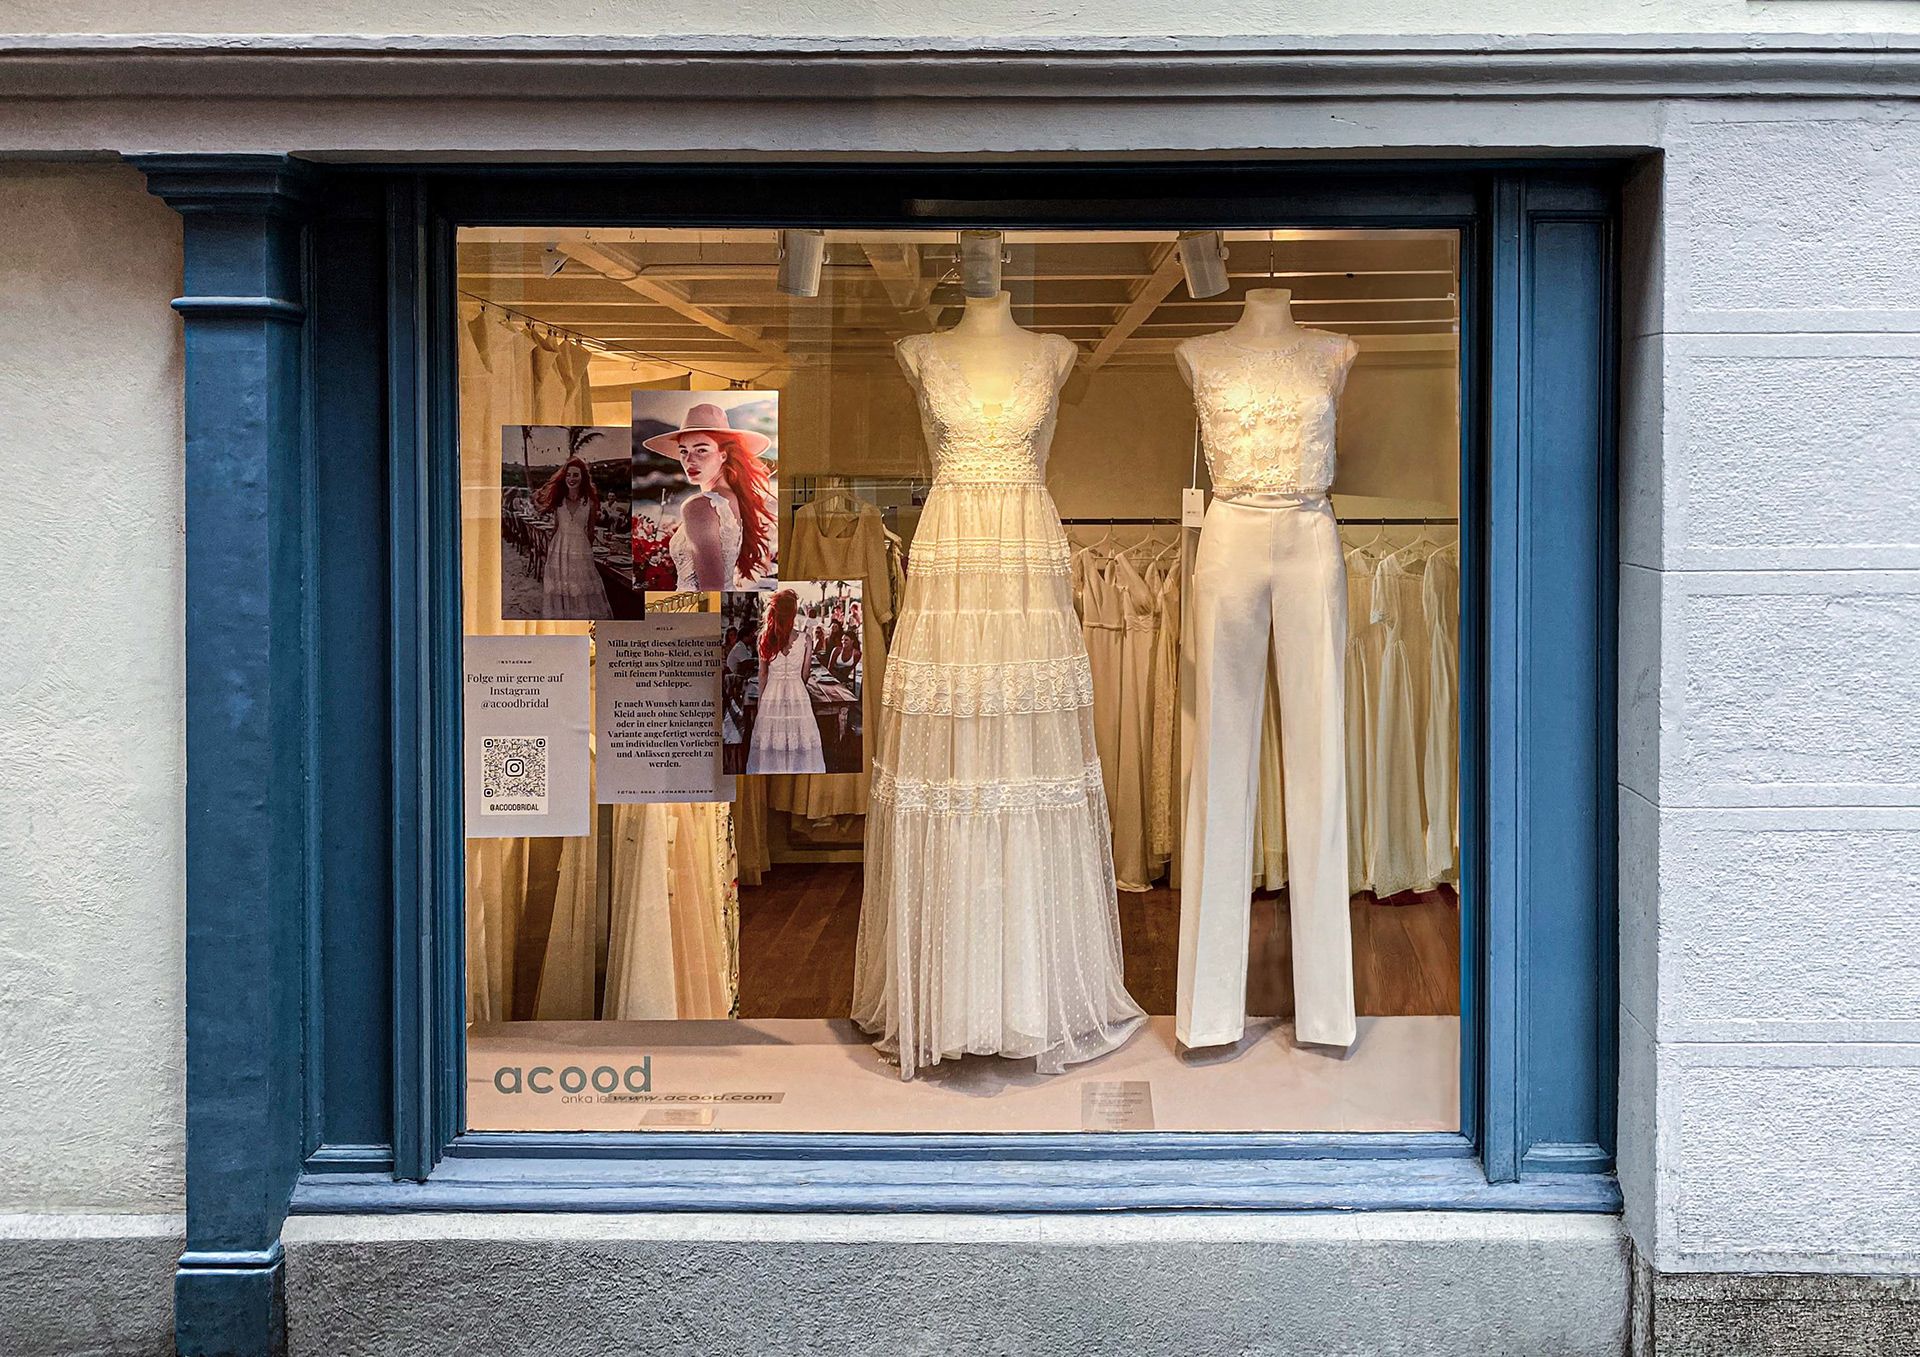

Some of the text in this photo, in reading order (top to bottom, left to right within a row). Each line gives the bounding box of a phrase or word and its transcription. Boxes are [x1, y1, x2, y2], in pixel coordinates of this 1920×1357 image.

[608, 639, 722, 650] Milla trägt dieses leichte und
[616, 650, 642, 660] luftige
[644, 649, 692, 659] Boho-Kleid,
[704, 649, 714, 658] ist
[608, 660, 643, 669] gefertigt
[661, 660, 685, 669] Spitze
[687, 660, 702, 668] und
[467, 673, 564, 684] Folge mir gerne auf
[614, 669, 716, 678] mit feinem Punktemuster
[636, 679, 692, 689] und Schleppe.
[490, 686, 540, 697] Instagram
[481, 698, 549, 709] @acoodbridal
[614, 700, 715, 709] Je nach Wunsch kann das
[614, 709, 716, 719] Kleid auch ohne Schleppe
[616, 719, 713, 729] oder in einer knielangen
[608, 730, 642, 738] Variante
[644, 730, 688, 740] angefertigt
[626, 740, 678, 748] individuellen
[680, 739, 719, 748] Vorlieben
[617, 750, 632, 758] und
[634, 749, 670, 758] Anlässen
[672, 750, 701, 759] gerecht
[649, 760, 681, 768] werden.
[489, 803, 539, 812] @ACOODBRIDAL
[494, 1056, 651, 1094] acood
[561, 1093, 593, 1104] anka
[613, 1093, 773, 1101] www.acood.com
